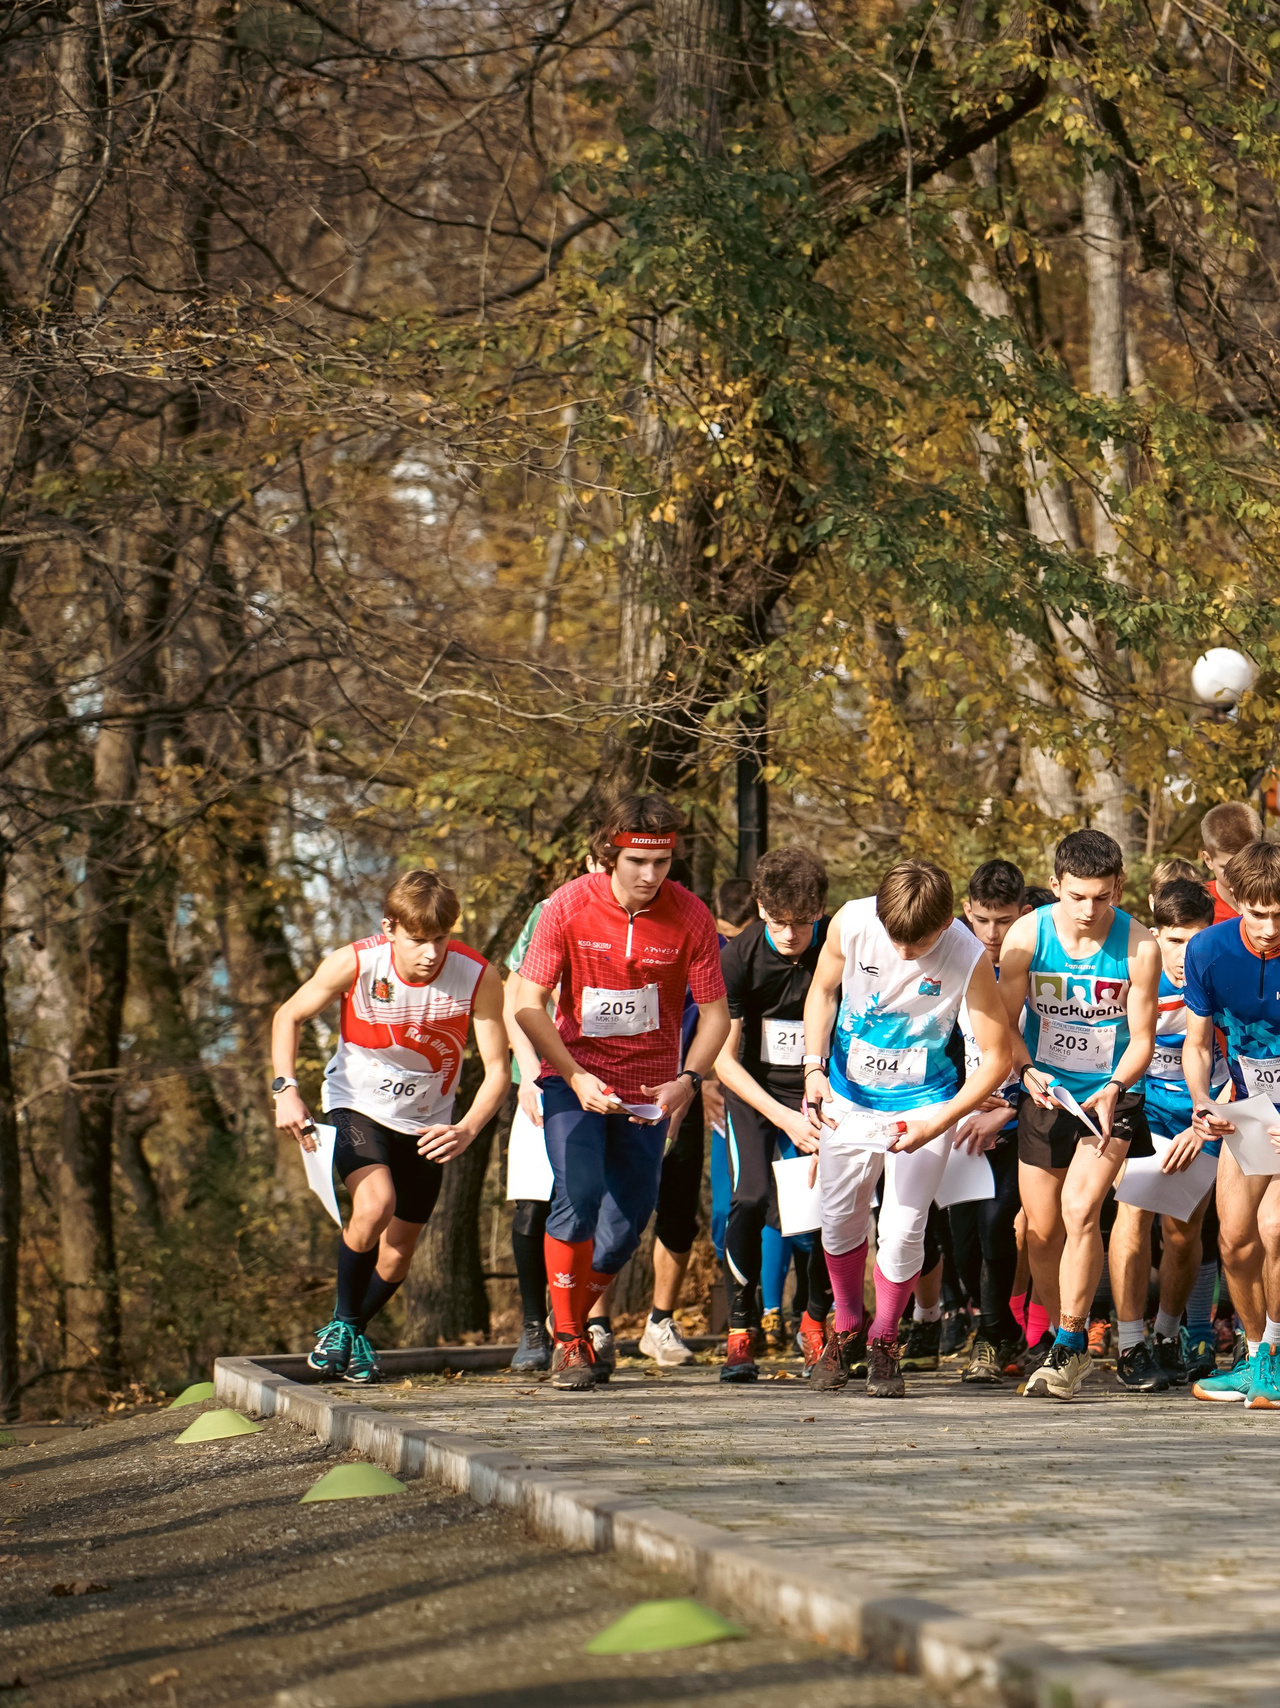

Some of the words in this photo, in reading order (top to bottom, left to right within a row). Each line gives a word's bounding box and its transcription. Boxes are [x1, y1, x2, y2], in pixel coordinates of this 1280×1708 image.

[600, 1001, 636, 1016] 205
[642, 1005, 647, 1014] 1
[1053, 1033, 1088, 1051] 203
[1094, 1045, 1100, 1054] 1
[865, 1055, 899, 1073] 204
[965, 1054, 980, 1067] 21
[380, 1078, 417, 1097] 206
